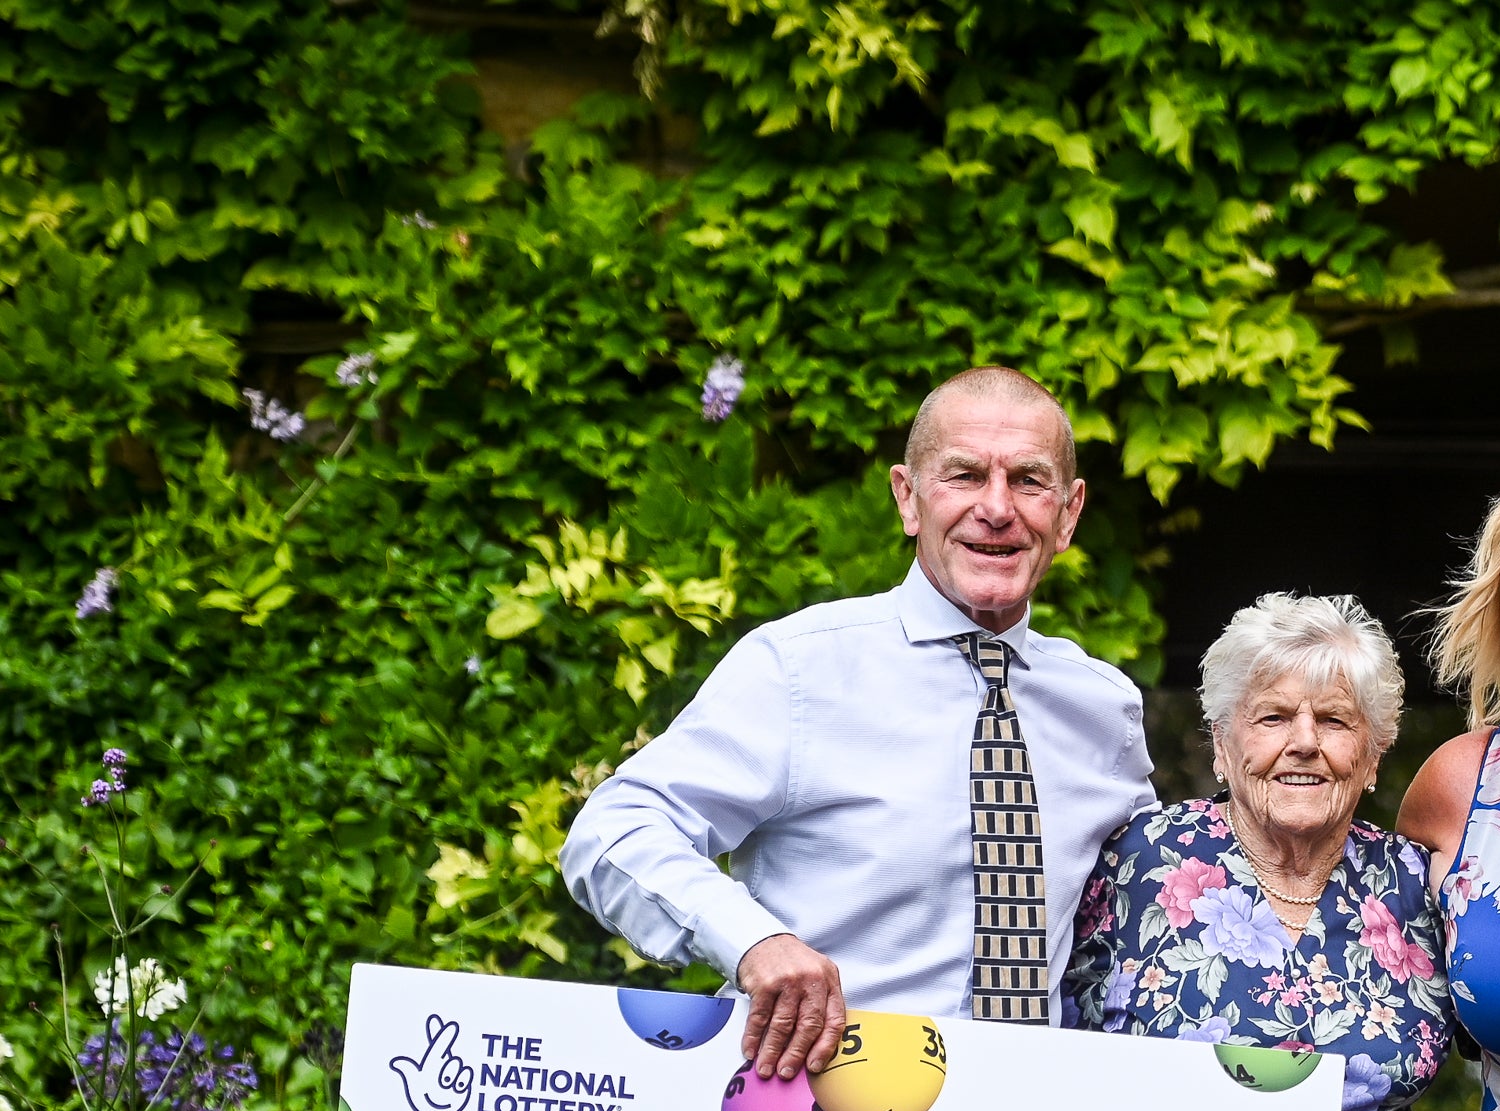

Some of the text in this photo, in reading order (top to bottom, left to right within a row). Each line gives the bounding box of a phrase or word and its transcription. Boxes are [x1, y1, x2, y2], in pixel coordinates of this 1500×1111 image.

[481, 1033, 543, 1061] THE
[833, 1024, 862, 1061] 5
[479, 1063, 635, 1100] NATIONAL
